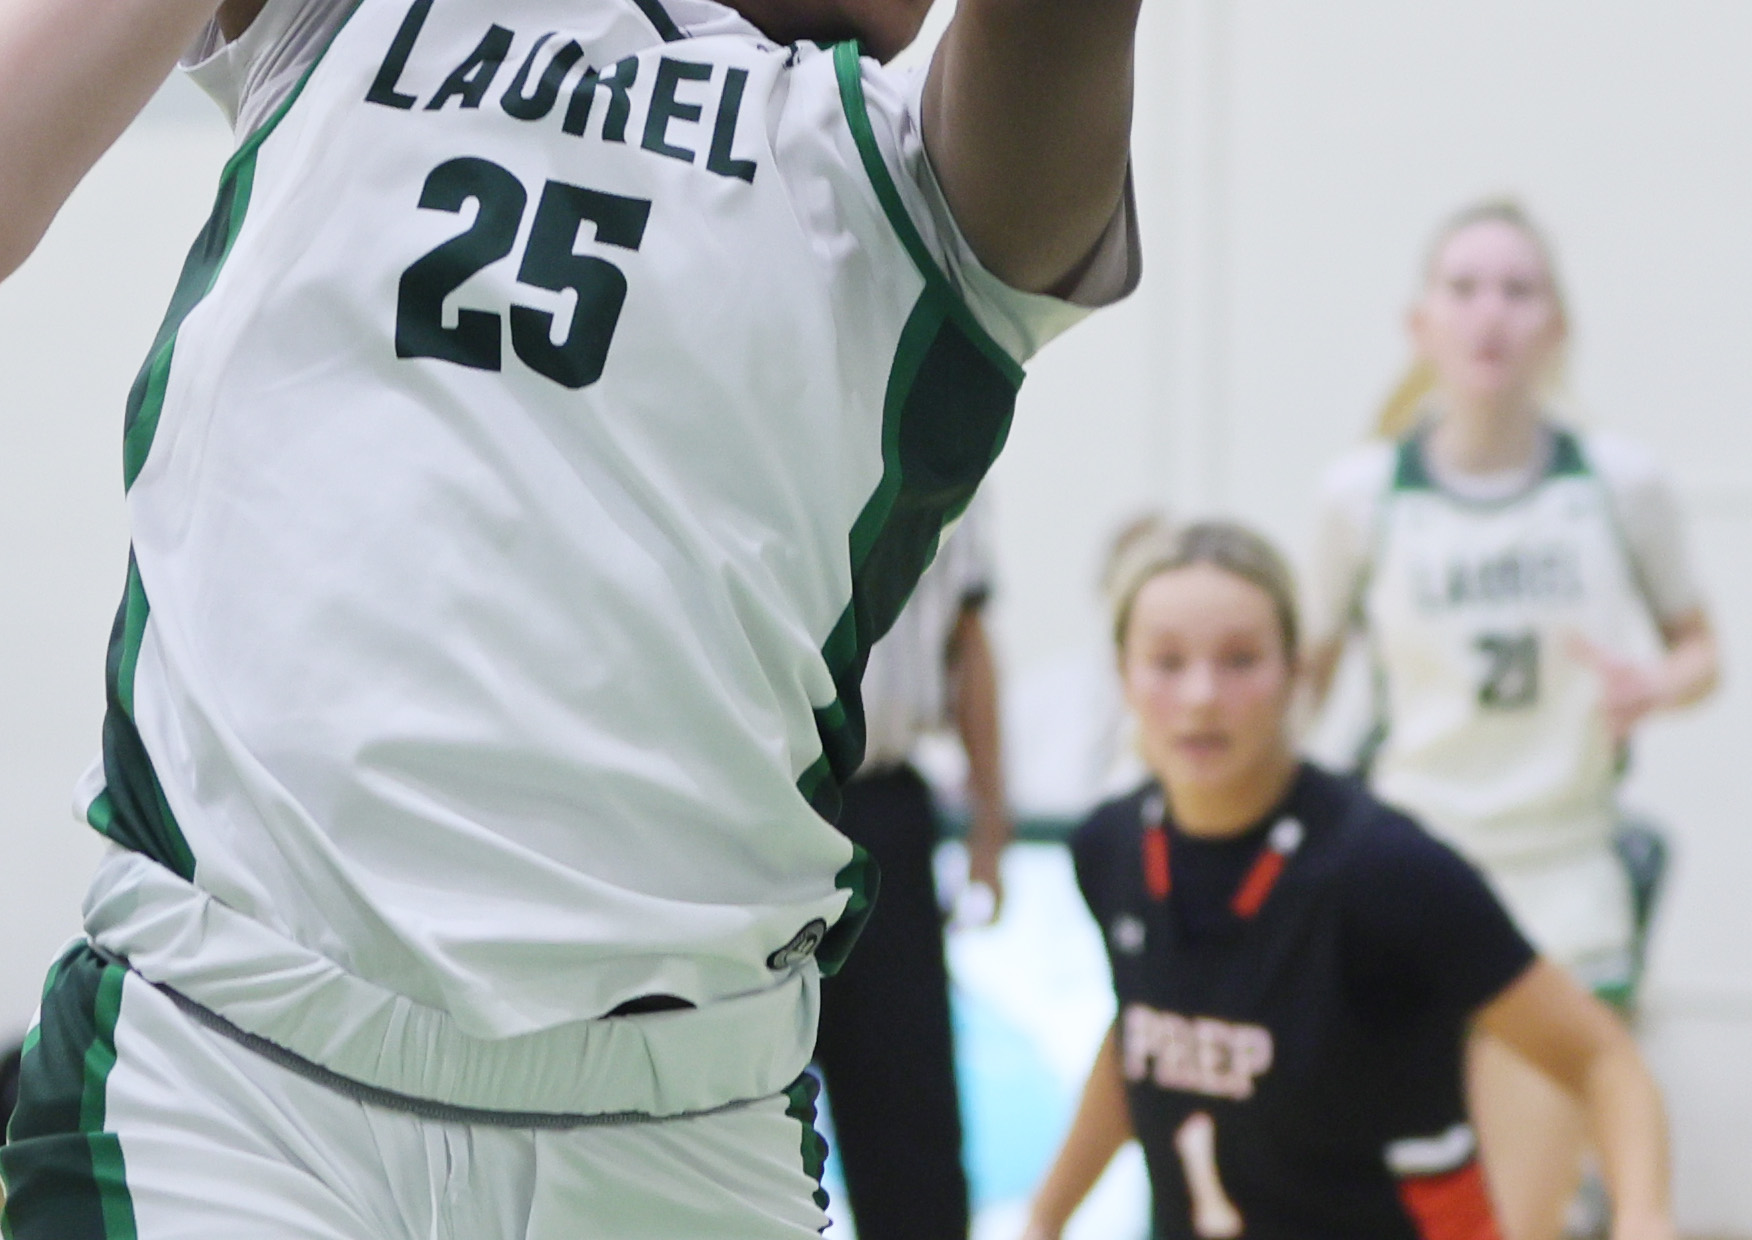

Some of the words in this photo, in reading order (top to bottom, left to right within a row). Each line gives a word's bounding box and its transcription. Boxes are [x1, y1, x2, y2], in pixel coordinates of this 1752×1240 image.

[395, 156, 652, 390] 25
[1122, 1003, 1275, 1101] PREP
[1174, 1111, 1245, 1239] 1
